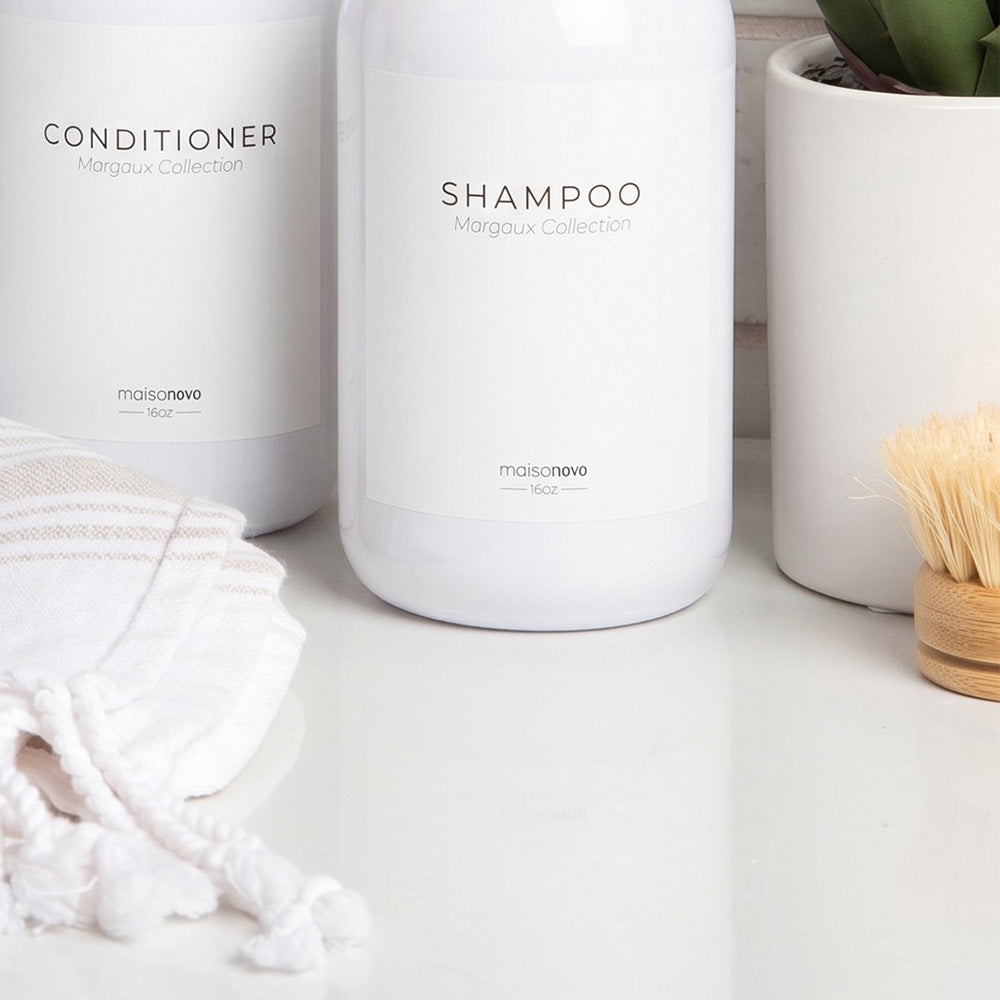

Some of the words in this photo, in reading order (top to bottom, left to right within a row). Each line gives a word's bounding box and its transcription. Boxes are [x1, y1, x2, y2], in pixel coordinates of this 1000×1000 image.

[43, 121, 277, 153] CONDITIONER
[77, 156, 154, 178] Margaux
[158, 155, 244, 175] Collection
[441, 181, 641, 211] SHAMPOO
[453, 215, 537, 239] Margaux
[541, 215, 632, 236] Collection
[117, 386, 202, 402] maisonovo
[146, 406, 174, 419] 16oz
[499, 462, 588, 479] maisonovo
[530, 483, 559, 496] 16oz
